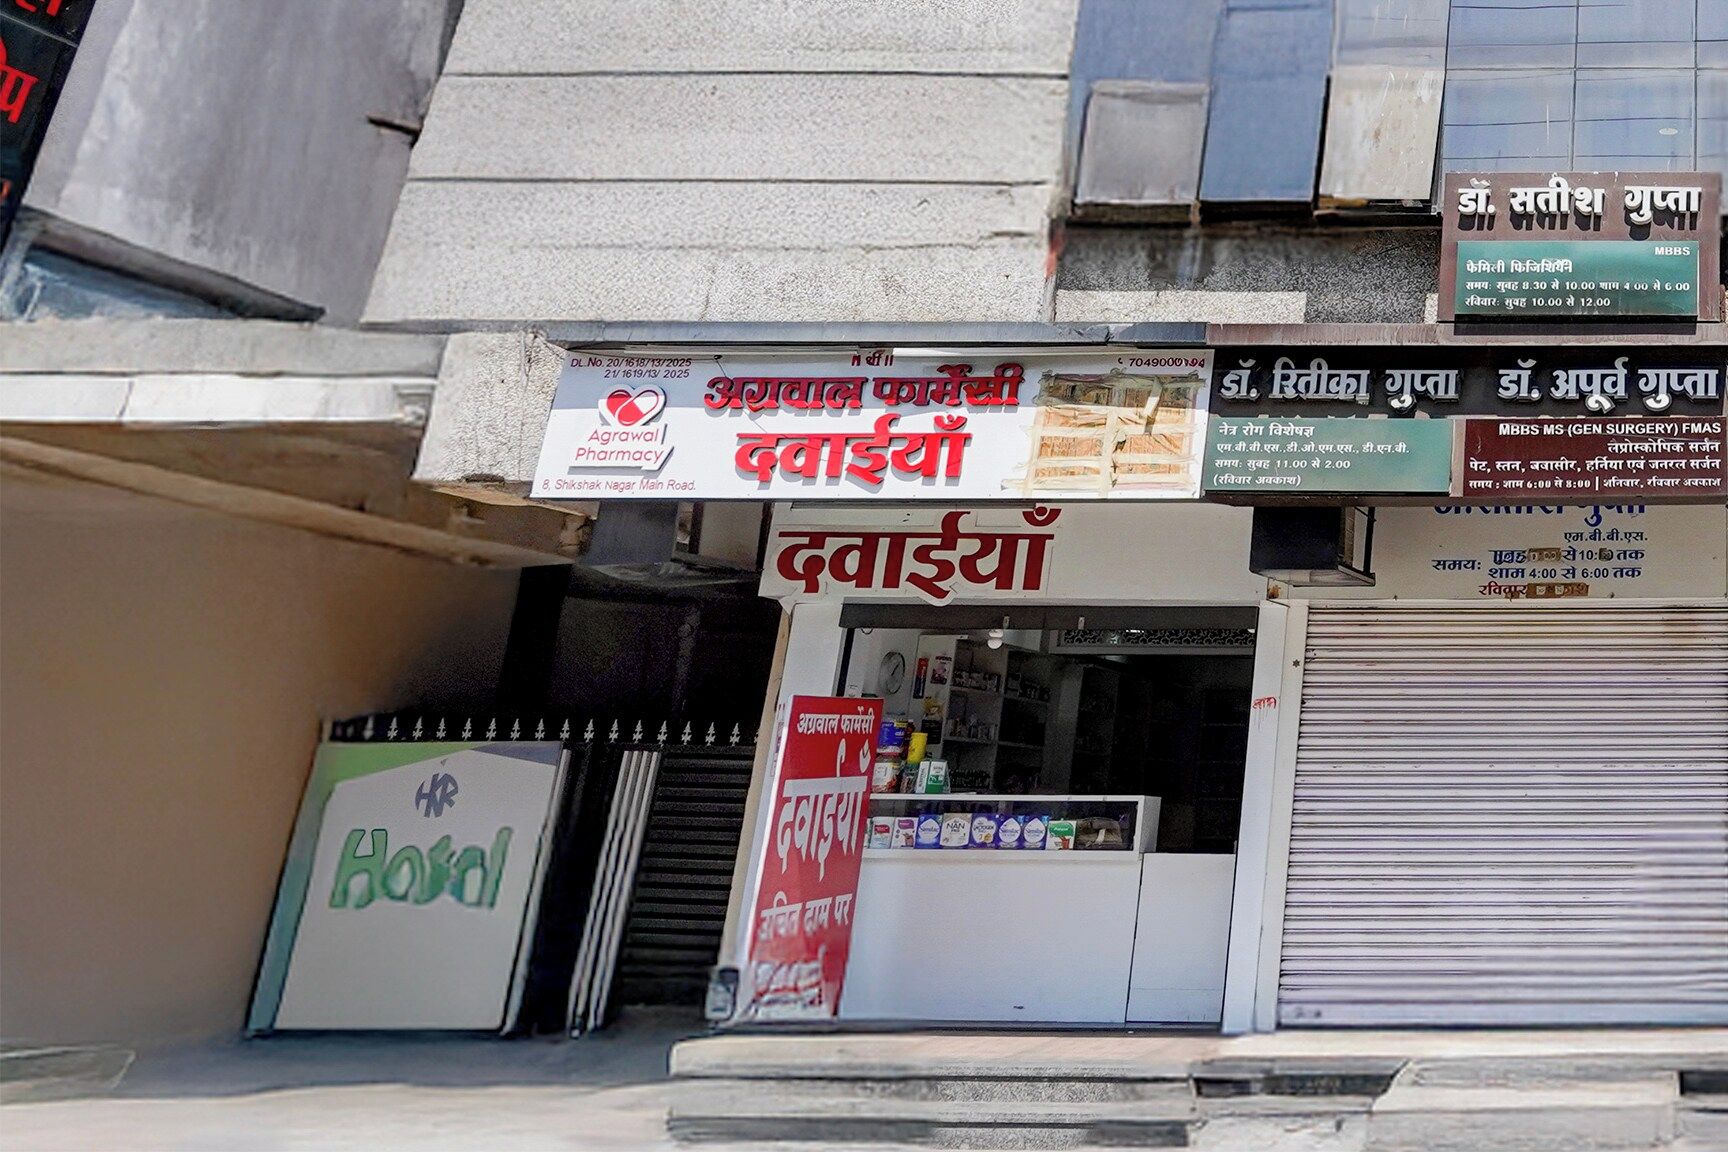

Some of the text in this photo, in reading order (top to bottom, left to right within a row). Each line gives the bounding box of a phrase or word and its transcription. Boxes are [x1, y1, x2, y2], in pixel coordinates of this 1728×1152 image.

[1457, 173, 1703, 225] डॉ. सतीश गुप्ता
[1655, 246, 1690, 256] MBBS
[1466, 259, 1505, 274] फैमिली
[1496, 280, 1518, 293] सुबह
[1551, 279, 1560, 290] से
[1565, 282, 1595, 290] 10.00
[1652, 279, 1660, 291] से
[1532, 298, 1563, 307] 10.00
[1566, 295, 1575, 307] से
[1580, 298, 1611, 307] 12.00
[606, 358, 692, 368] 20/1618/13/2025
[1221, 357, 1460, 410] डॉ. रितीका गुप्ता
[1498, 356, 1719, 413] डॉ. अपूर्व गुप्ता
[704, 374, 867, 412] अग्रवाल
[588, 429, 659, 445] Agrawal
[1219, 422, 1315, 437] नेत्र रोग विशेषज्ञ
[1499, 422, 1722, 437] MBBS MS (GEN SURGERY) FMAS
[735, 413, 974, 487] दवाईयाँ
[1689, 438, 1720, 453] सर्जन
[575, 447, 664, 464] Pharmacy
[1586, 457, 1623, 471] हर्निया
[1627, 455, 1645, 472] एवं
[1649, 459, 1686, 470] जनरल
[1689, 455, 1721, 470] सर्जन
[1247, 459, 1270, 472] सुबह
[1275, 460, 1308, 469] 11.00
[1311, 456, 1320, 468] से
[1324, 460, 1351, 469] 2.00
[555, 479, 601, 490] Shikshak
[605, 480, 635, 492] Nagar
[640, 479, 664, 490] Main
[1503, 479, 1524, 489] शाम
[1526, 479, 1551, 489] 6:00
[1554, 477, 1564, 489] से
[1566, 479, 1591, 488] 8:00
[776, 506, 1062, 600] दवाईयाँ
[1561, 545, 1645, 563] से तक
[1432, 558, 1481, 571] समय:
[1488, 565, 1642, 580] शाम 4:00 से 6:00 तक
[797, 713, 840, 736] अग्रवाल
[777, 738, 871, 882] दवाईयाँ
[833, 893, 853, 927] पर
